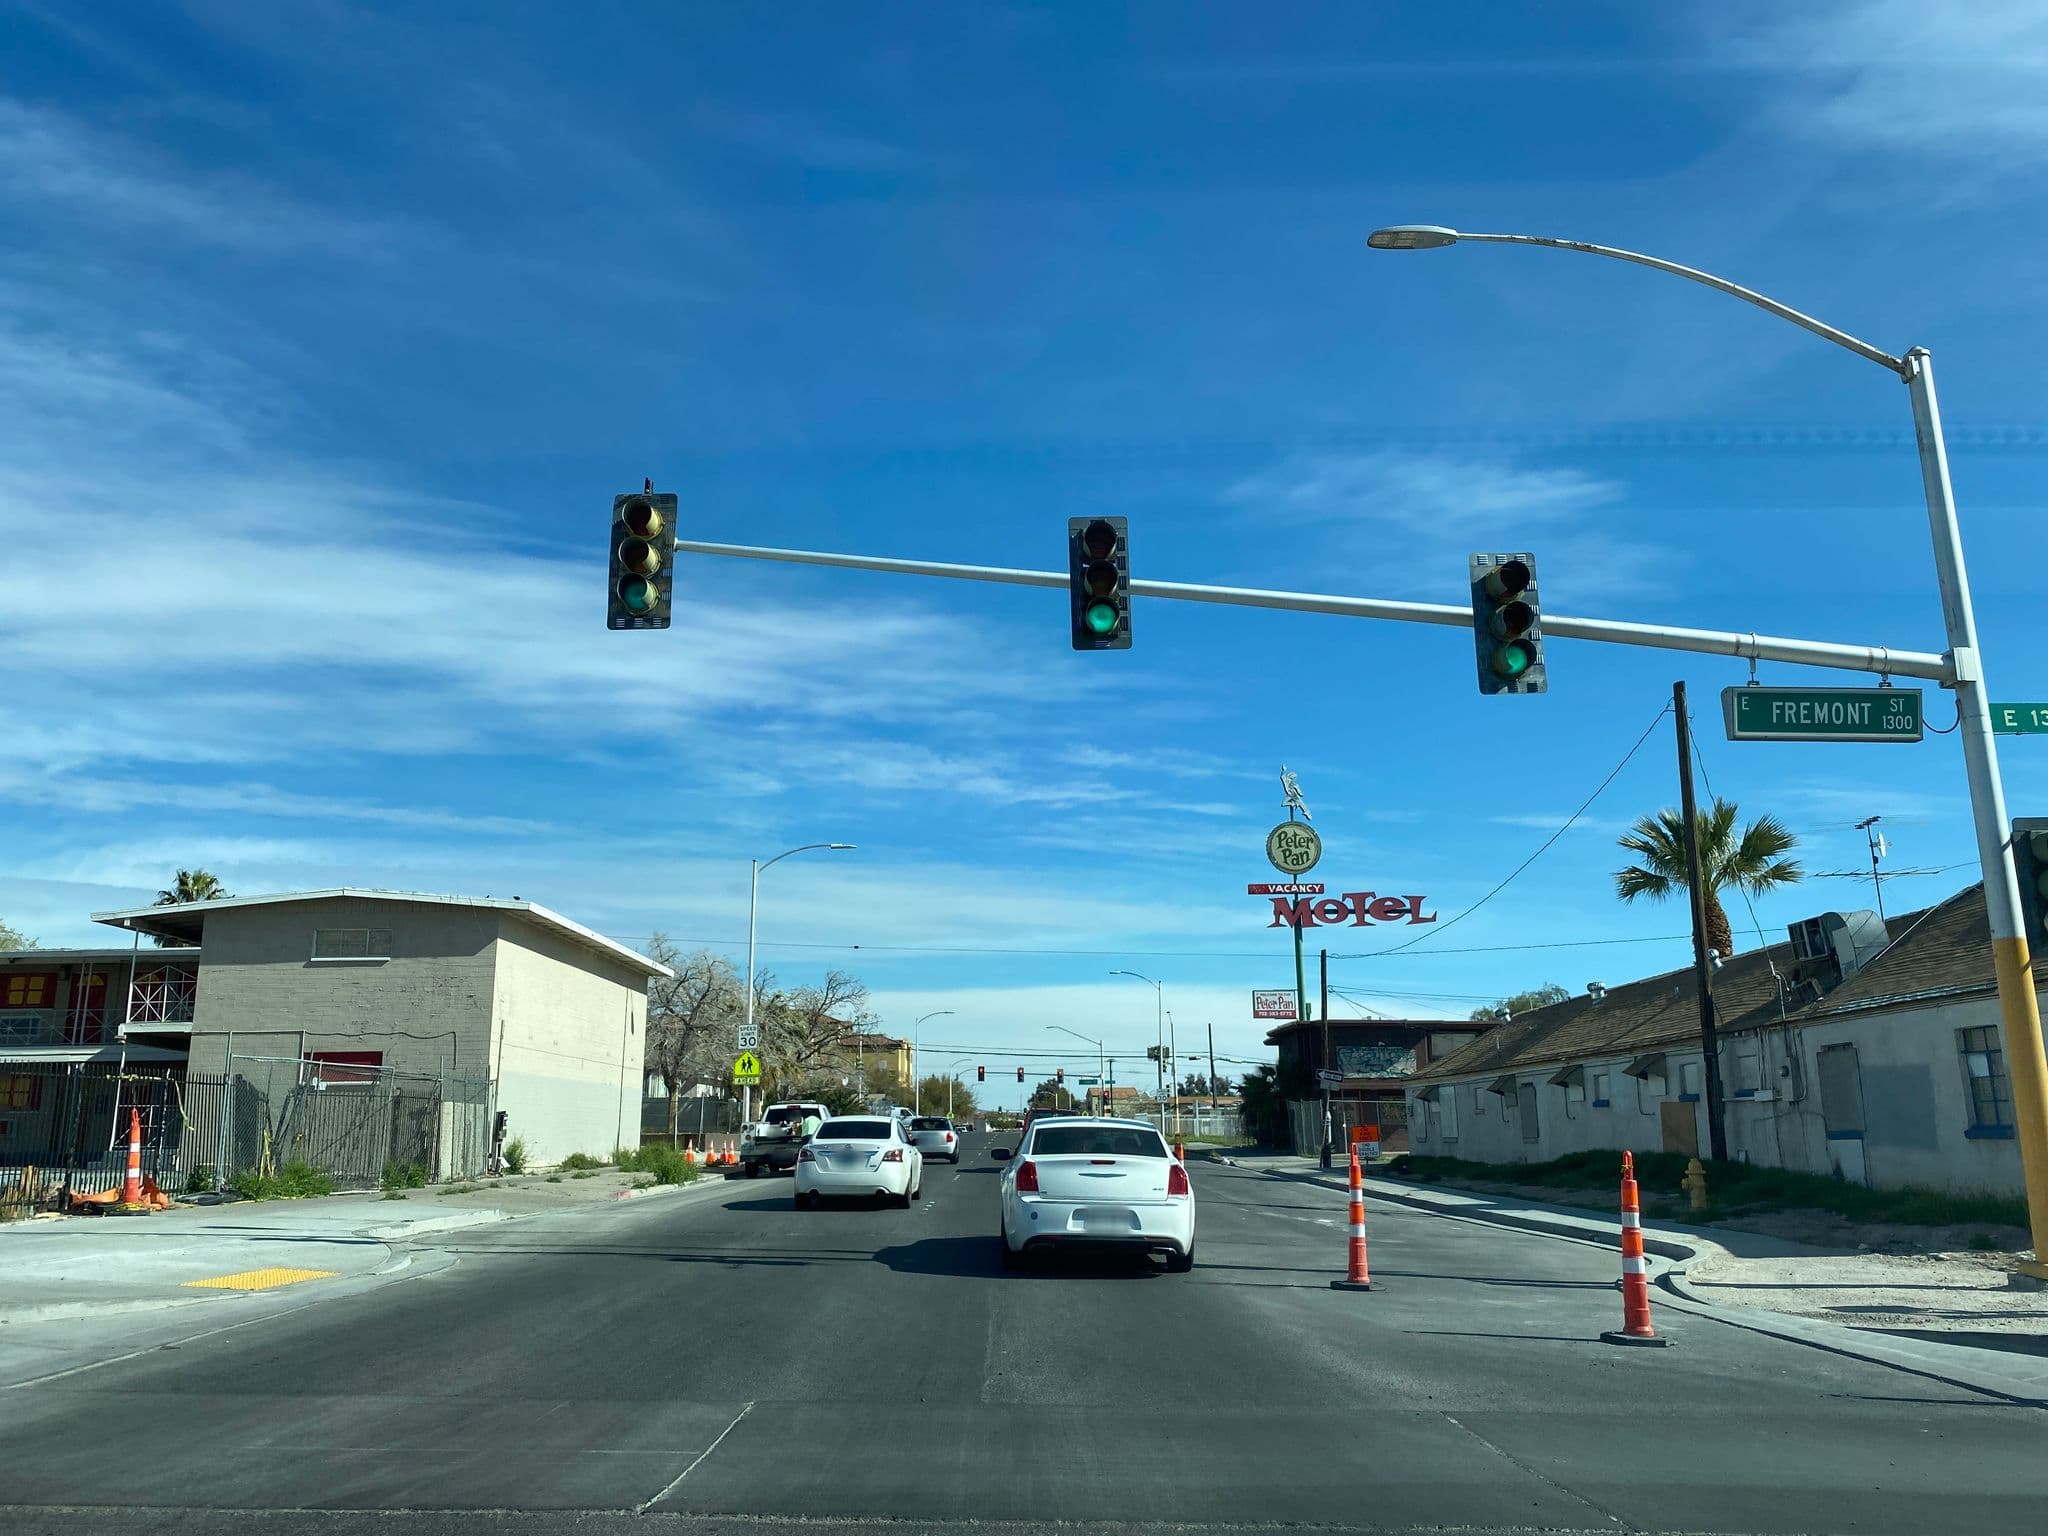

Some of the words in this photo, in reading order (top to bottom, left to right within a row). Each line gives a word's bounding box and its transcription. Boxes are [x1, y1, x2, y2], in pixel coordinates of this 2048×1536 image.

[1741, 696, 1750, 710] E
[1772, 701, 1872, 724] FREMONT
[1890, 698, 1905, 712] ST
[1883, 715, 1913, 730] 1300
[2004, 710, 2018, 726] E
[1276, 830, 1314, 850] Peter
[1281, 848, 1311, 866] Pan
[1268, 884, 1321, 893] VACANCY
[1278, 996, 1294, 1009] Pan
[740, 1037, 756, 1047] 30
